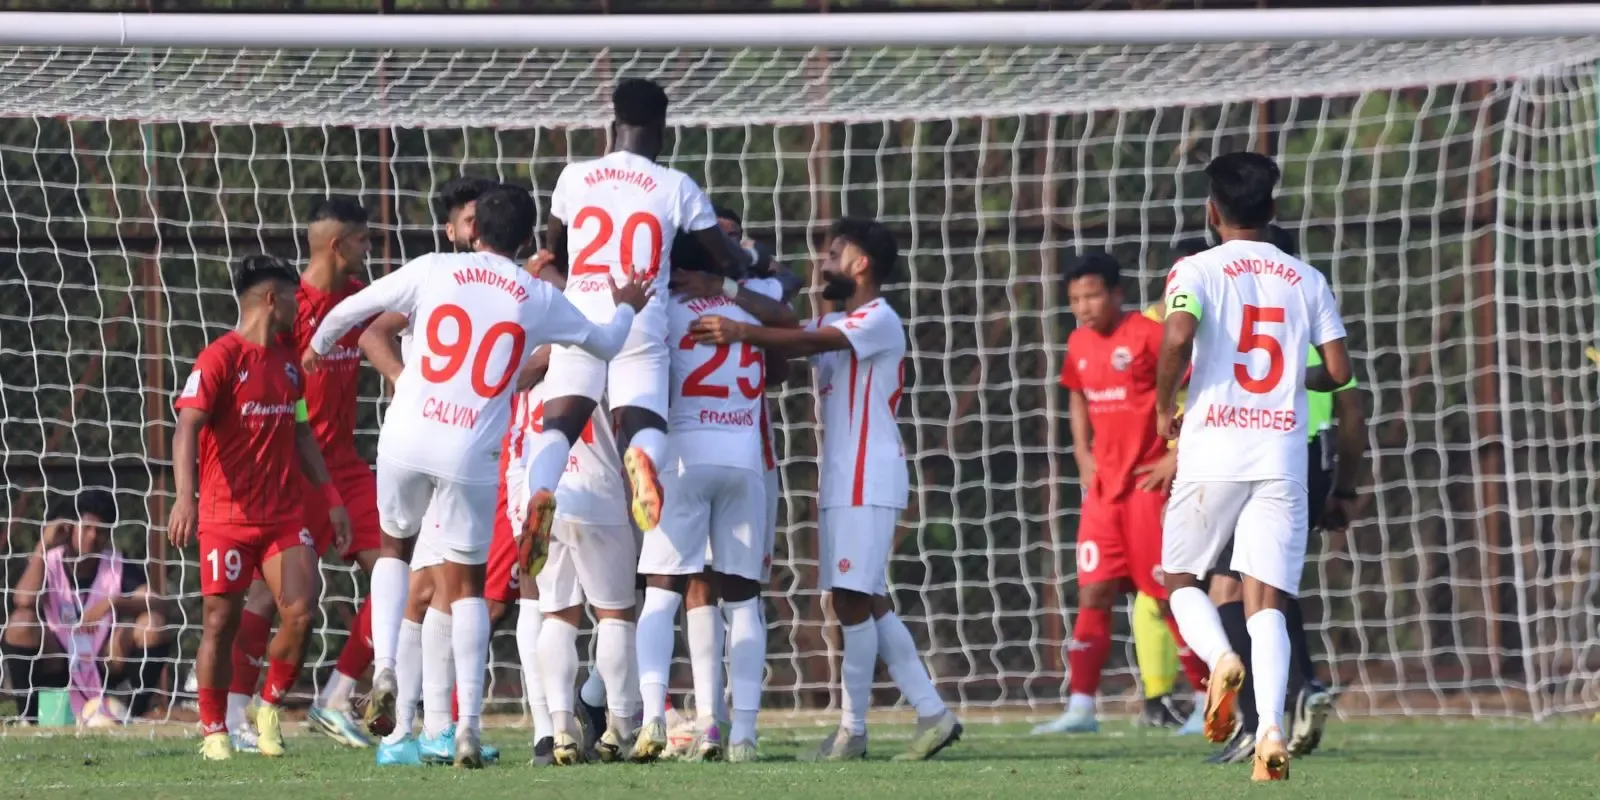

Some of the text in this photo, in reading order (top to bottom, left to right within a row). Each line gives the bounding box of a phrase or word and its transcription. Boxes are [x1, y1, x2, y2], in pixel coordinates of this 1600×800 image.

[584, 168, 657, 193] NAMDHARI
[571, 206, 663, 280] 20
[453, 268, 530, 303] NAMDHARI
[1223, 259, 1303, 286] NAMDHARI
[1172, 295, 1188, 308] C
[421, 304, 526, 399] 90
[679, 332, 766, 400] 25
[1233, 304, 1285, 394] 5
[422, 398, 480, 429] CALVIN
[207, 548, 242, 582] 19
